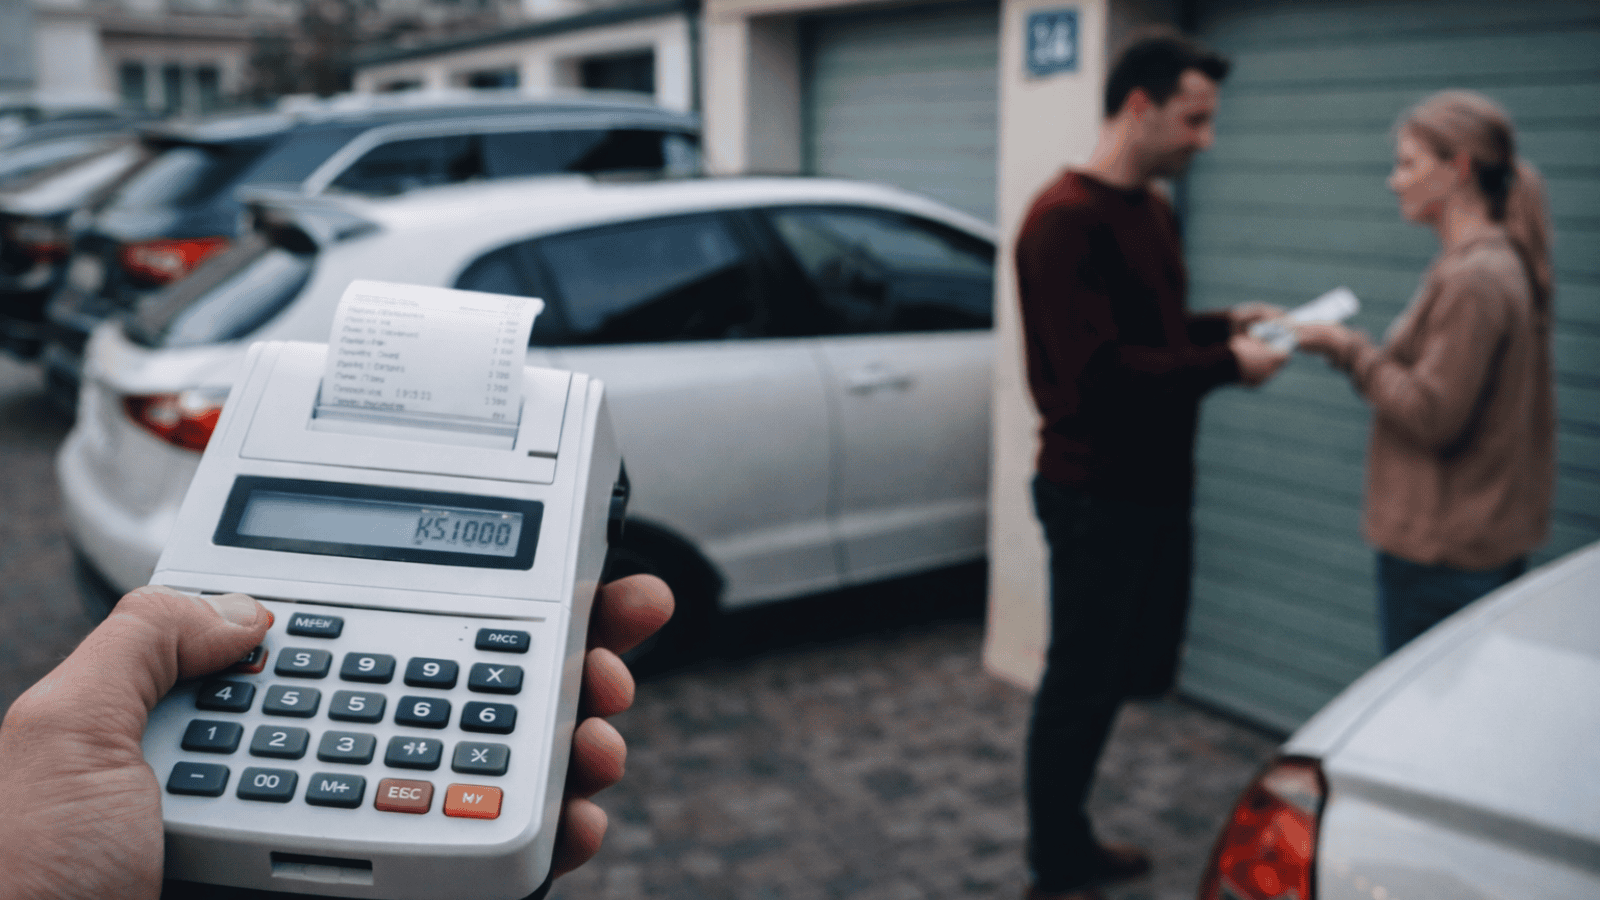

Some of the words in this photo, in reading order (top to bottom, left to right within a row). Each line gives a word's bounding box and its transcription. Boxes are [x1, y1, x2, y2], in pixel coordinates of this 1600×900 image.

[358, 657, 376, 672] 9
[423, 662, 440, 677] 9
[215, 686, 232, 701] 4
[280, 691, 299, 706] 5
[347, 696, 366, 711] 5
[413, 701, 432, 717] 6
[478, 707, 496, 723] 6
[207, 726, 217, 740] 1
[268, 732, 287, 747] 2
[336, 736, 355, 752] 3
